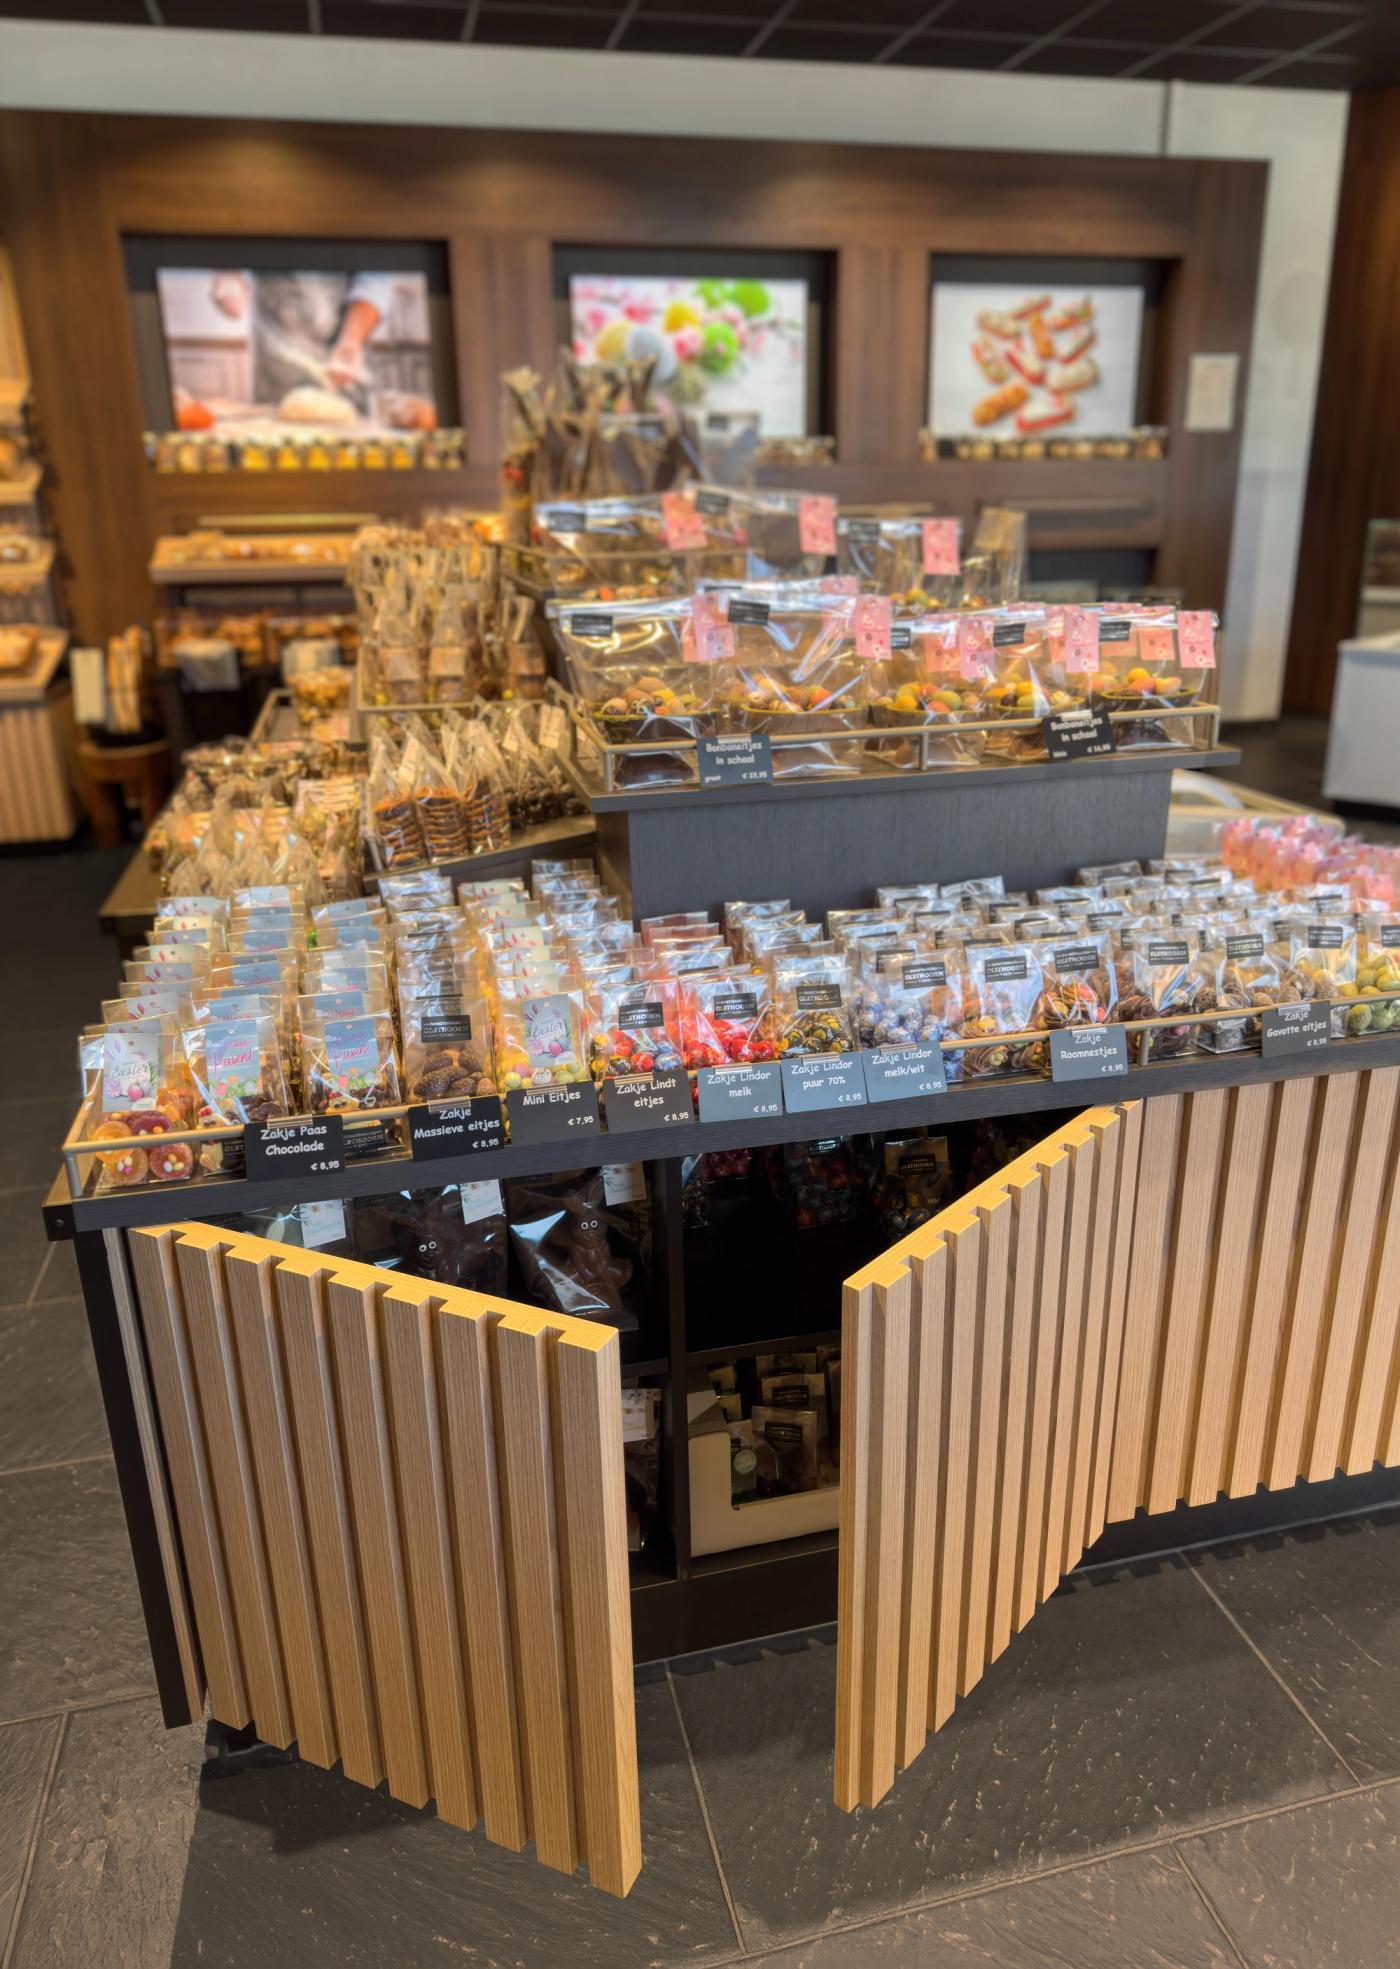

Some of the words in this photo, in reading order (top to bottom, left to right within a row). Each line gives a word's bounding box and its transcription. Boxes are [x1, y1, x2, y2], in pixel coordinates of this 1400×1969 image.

[1284, 1011, 1309, 1022] Zakje
[1266, 1025, 1299, 1038] Gavotte
[1302, 1021, 1327, 1033] eitjes
[1075, 1033, 1101, 1045] Zakje
[871, 1054, 900, 1065] Zakje
[902, 1049, 932, 1060] Lindor
[1060, 1046, 1118, 1059] Roomnestjes
[791, 1064, 820, 1076] Zakje
[823, 1060, 853, 1071] Lindor
[884, 1064, 925, 1078] melk/wit
[1101, 1065, 1107, 1073] €
[707, 1074, 737, 1085] Zakje
[740, 1071, 771, 1082] Lindor
[803, 1079, 824, 1091] puur
[827, 1076, 846, 1085] 70%
[617, 1084, 647, 1095] Zakje
[650, 1078, 677, 1090] Lindt
[729, 1087, 752, 1098] melk
[523, 1095, 545, 1106] Mini
[549, 1090, 581, 1104] Eitjes
[634, 1096, 664, 1108] eitjes
[440, 1108, 472, 1120] Zakje
[761, 1104, 778, 1113] 8,95
[568, 1118, 575, 1126] €
[576, 1116, 594, 1125] 7,95
[671, 1112, 689, 1121] 8,95
[260, 1128, 296, 1141] Zakje
[300, 1125, 328, 1136] Paas
[414, 1125, 464, 1139] Massieve
[468, 1119, 500, 1132] eitjes
[343, 1134, 384, 1146] STHOORN
[472, 1141, 479, 1149] €
[480, 1138, 499, 1148] 8,95
[265, 1140, 325, 1156] Chocolade
[310, 1163, 318, 1171] €
[319, 1160, 340, 1171] 8,95
